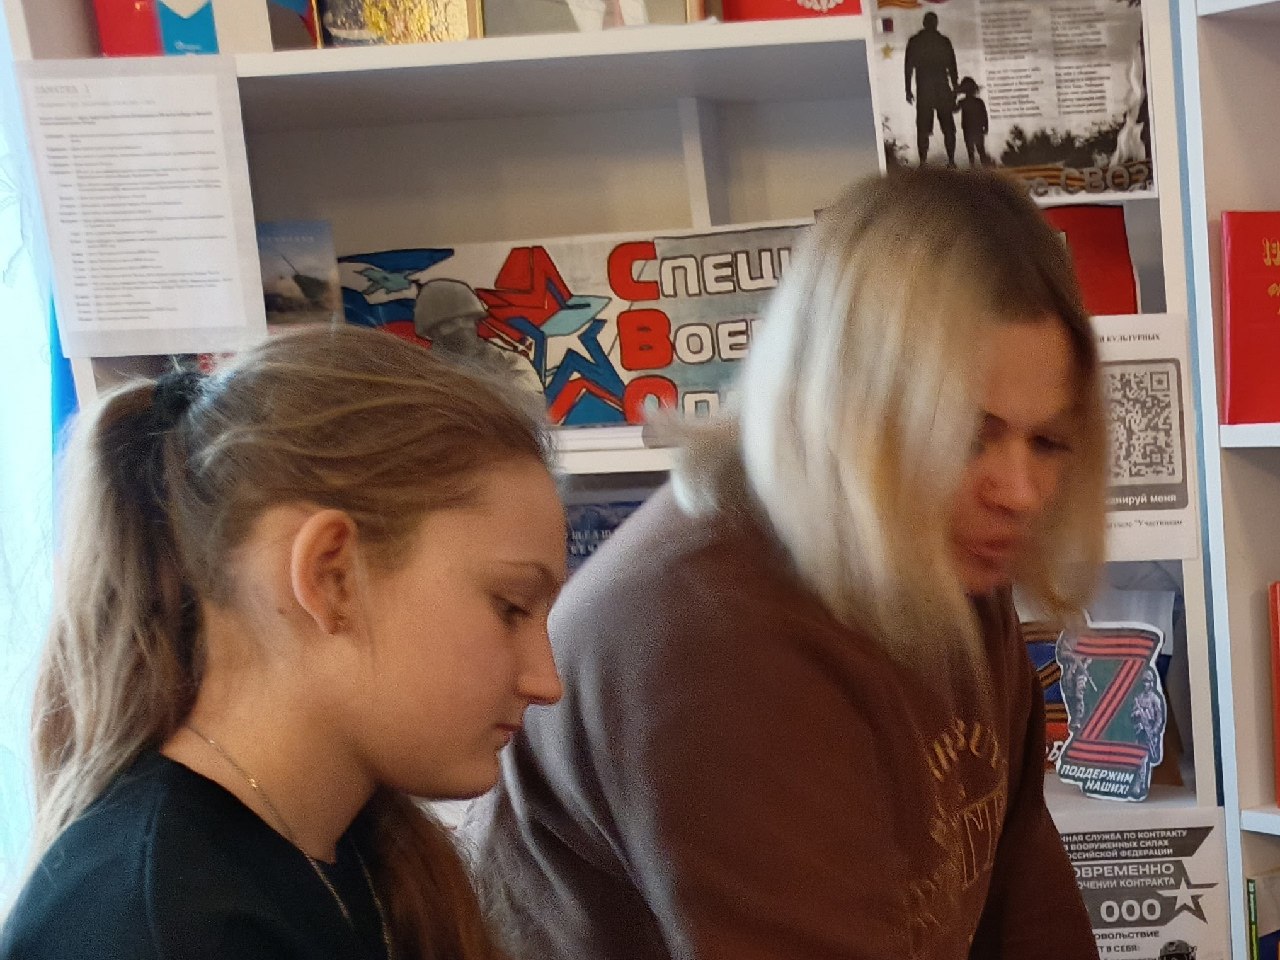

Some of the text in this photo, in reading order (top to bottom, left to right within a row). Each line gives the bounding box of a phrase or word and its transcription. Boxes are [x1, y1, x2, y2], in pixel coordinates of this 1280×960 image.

[607, 240, 793, 300] СПЕЦ
[1060, 763, 1135, 783] ПОДДЕРЖИМ
[1085, 779, 1130, 795] НАШИХ!
[1085, 833, 1121, 841] СЛУЖБА
[1123, 831, 1136, 839] ПО
[1138, 830, 1188, 838] КОНТРАКТУ
[1070, 839, 1170, 850] ВООРУЖЕННЫХ СИЛАХ
[1120, 848, 1173, 857] ФЕДЕРАЦИИ
[1119, 877, 1176, 888] КОНТРАКТА
[1094, 930, 1160, 940] ОВОЛЬСТВИЕ
